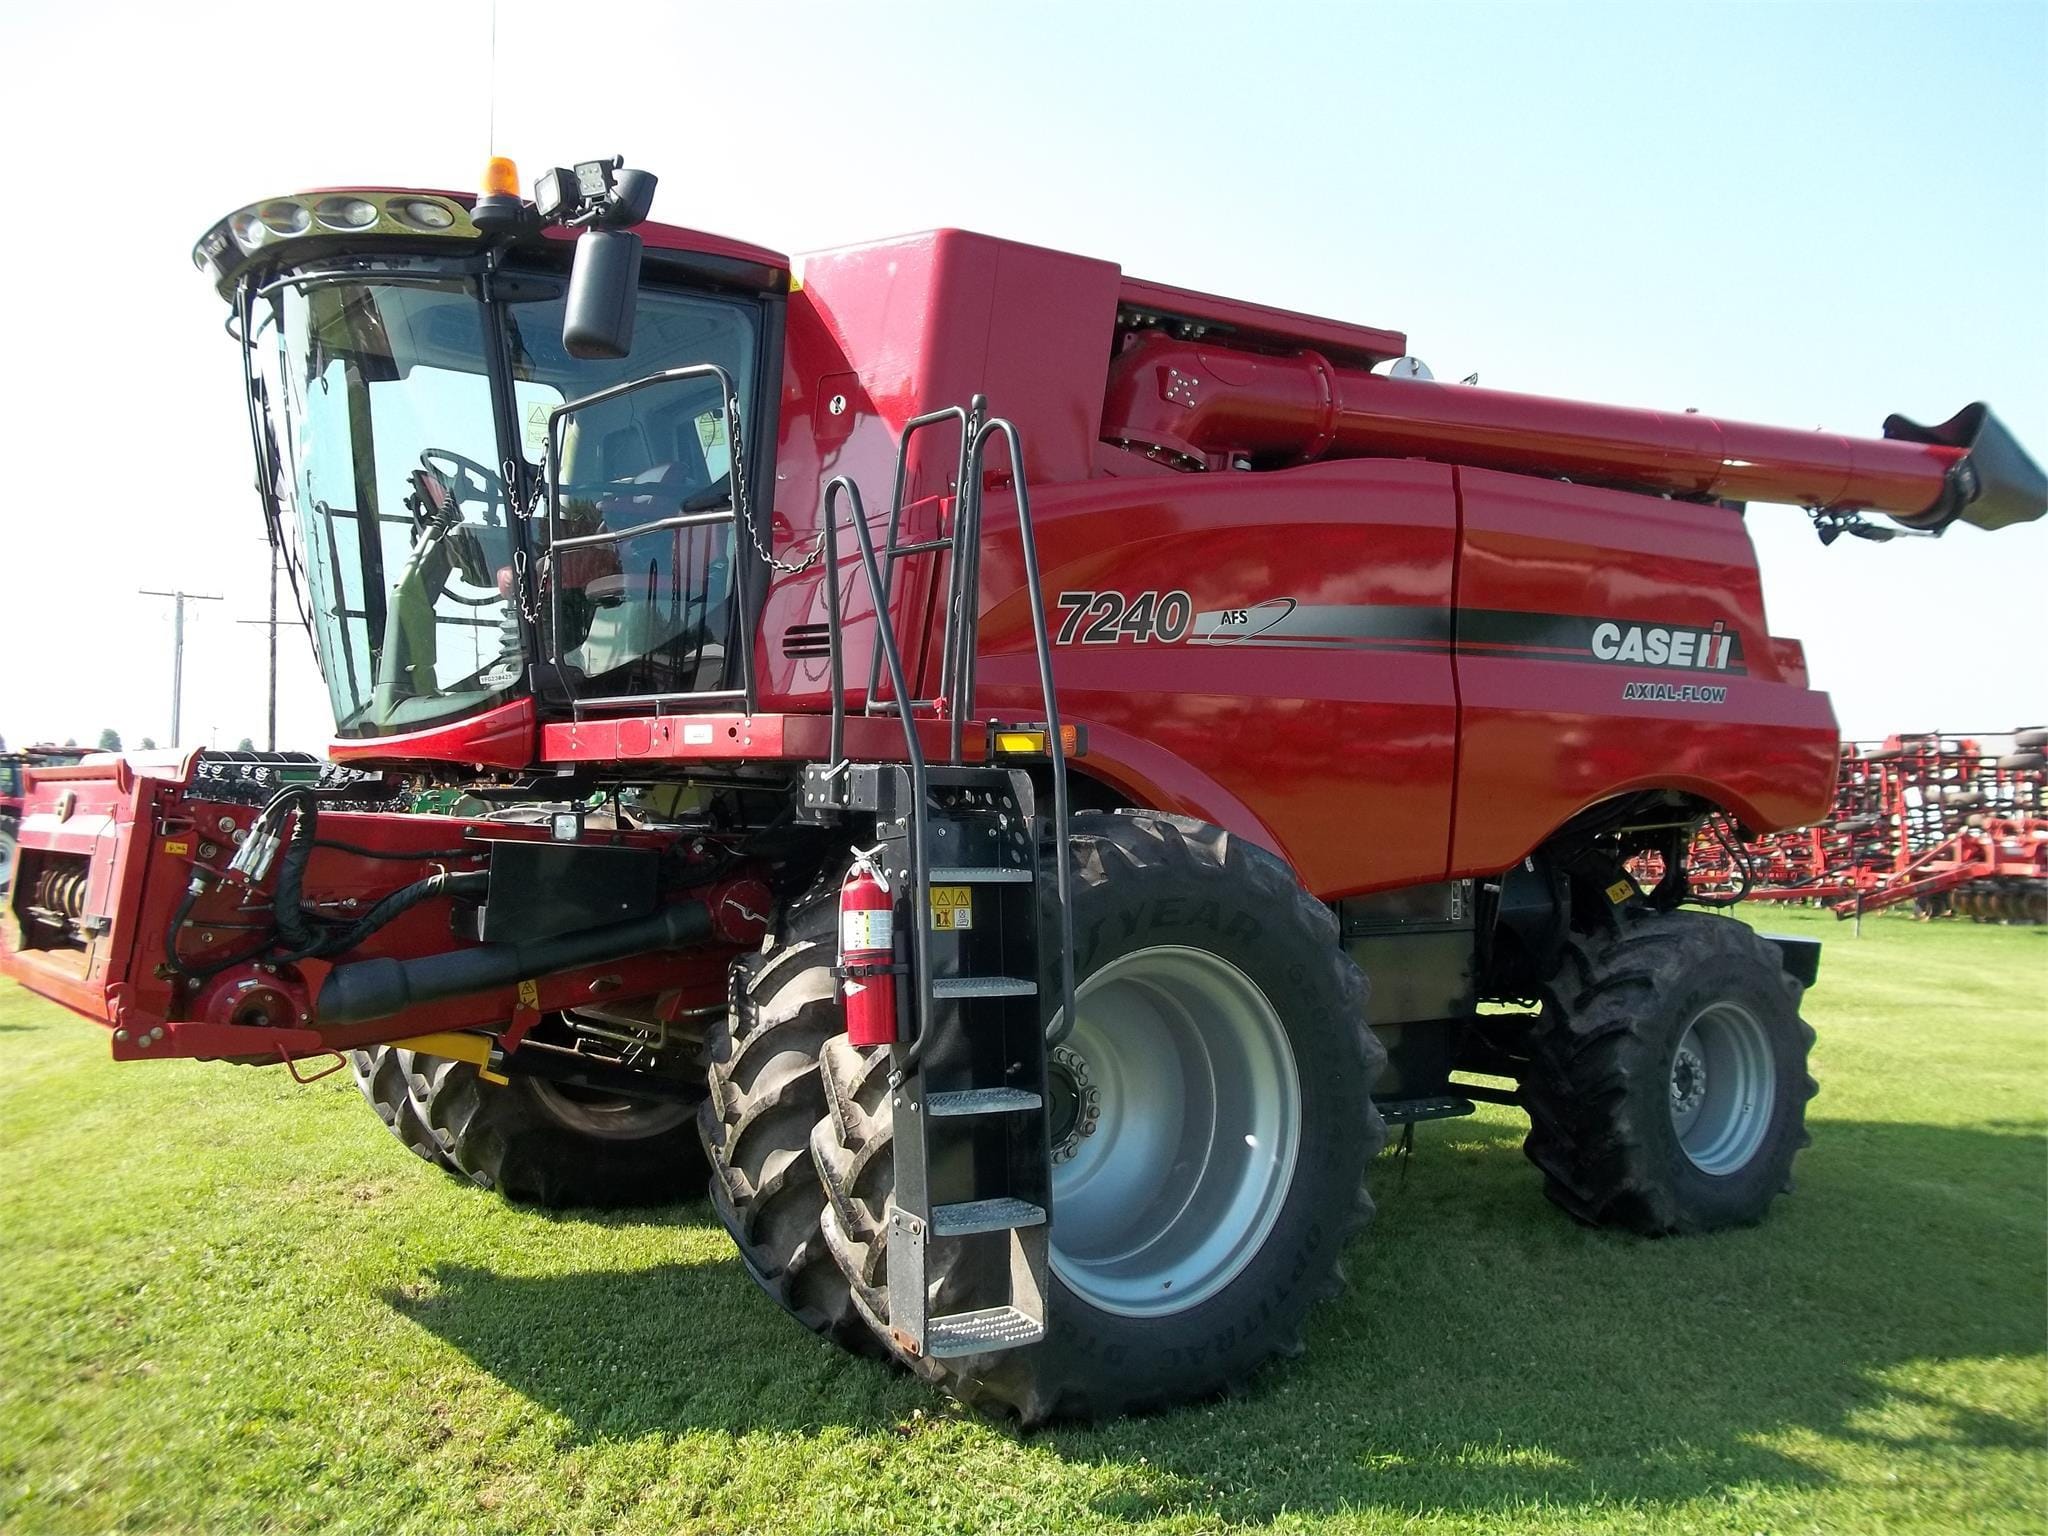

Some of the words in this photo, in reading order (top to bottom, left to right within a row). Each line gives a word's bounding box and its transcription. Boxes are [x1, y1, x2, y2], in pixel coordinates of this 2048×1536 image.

[1056, 590, 1193, 645] 7240
[1220, 609, 1248, 626] AFS
[1623, 682, 1727, 704] AXIAL-FLOW
